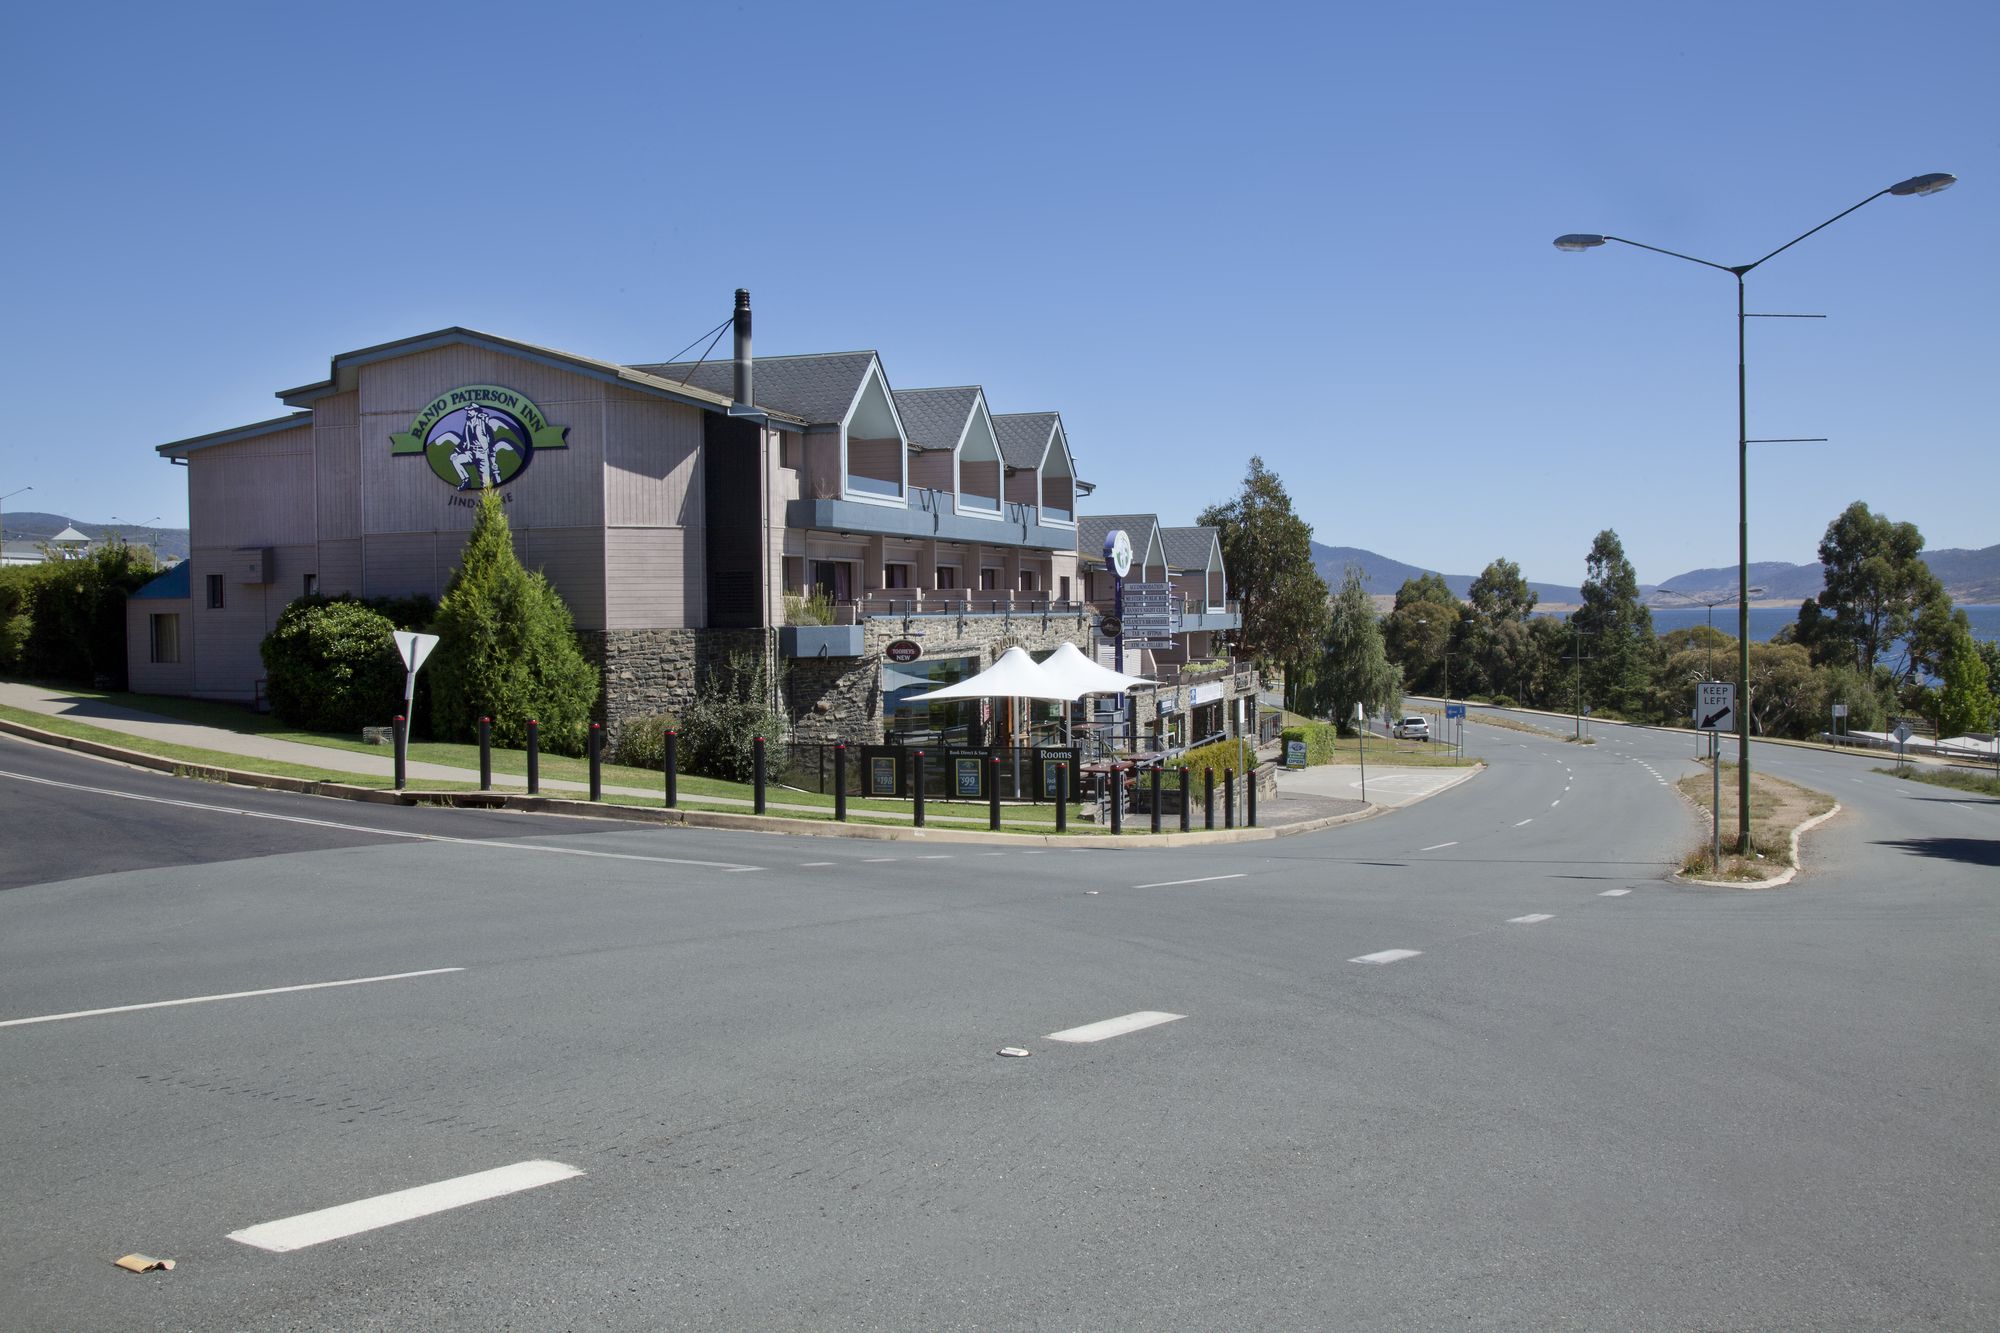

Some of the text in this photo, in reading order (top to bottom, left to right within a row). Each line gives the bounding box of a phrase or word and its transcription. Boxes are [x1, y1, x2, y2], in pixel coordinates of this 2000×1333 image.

[411, 389, 545, 439] BANJO PATERSON INN
[1703, 687, 1728, 695] KEEP
[1704, 697, 1727, 705] LEFT
[1040, 750, 1072, 759] Rooms
